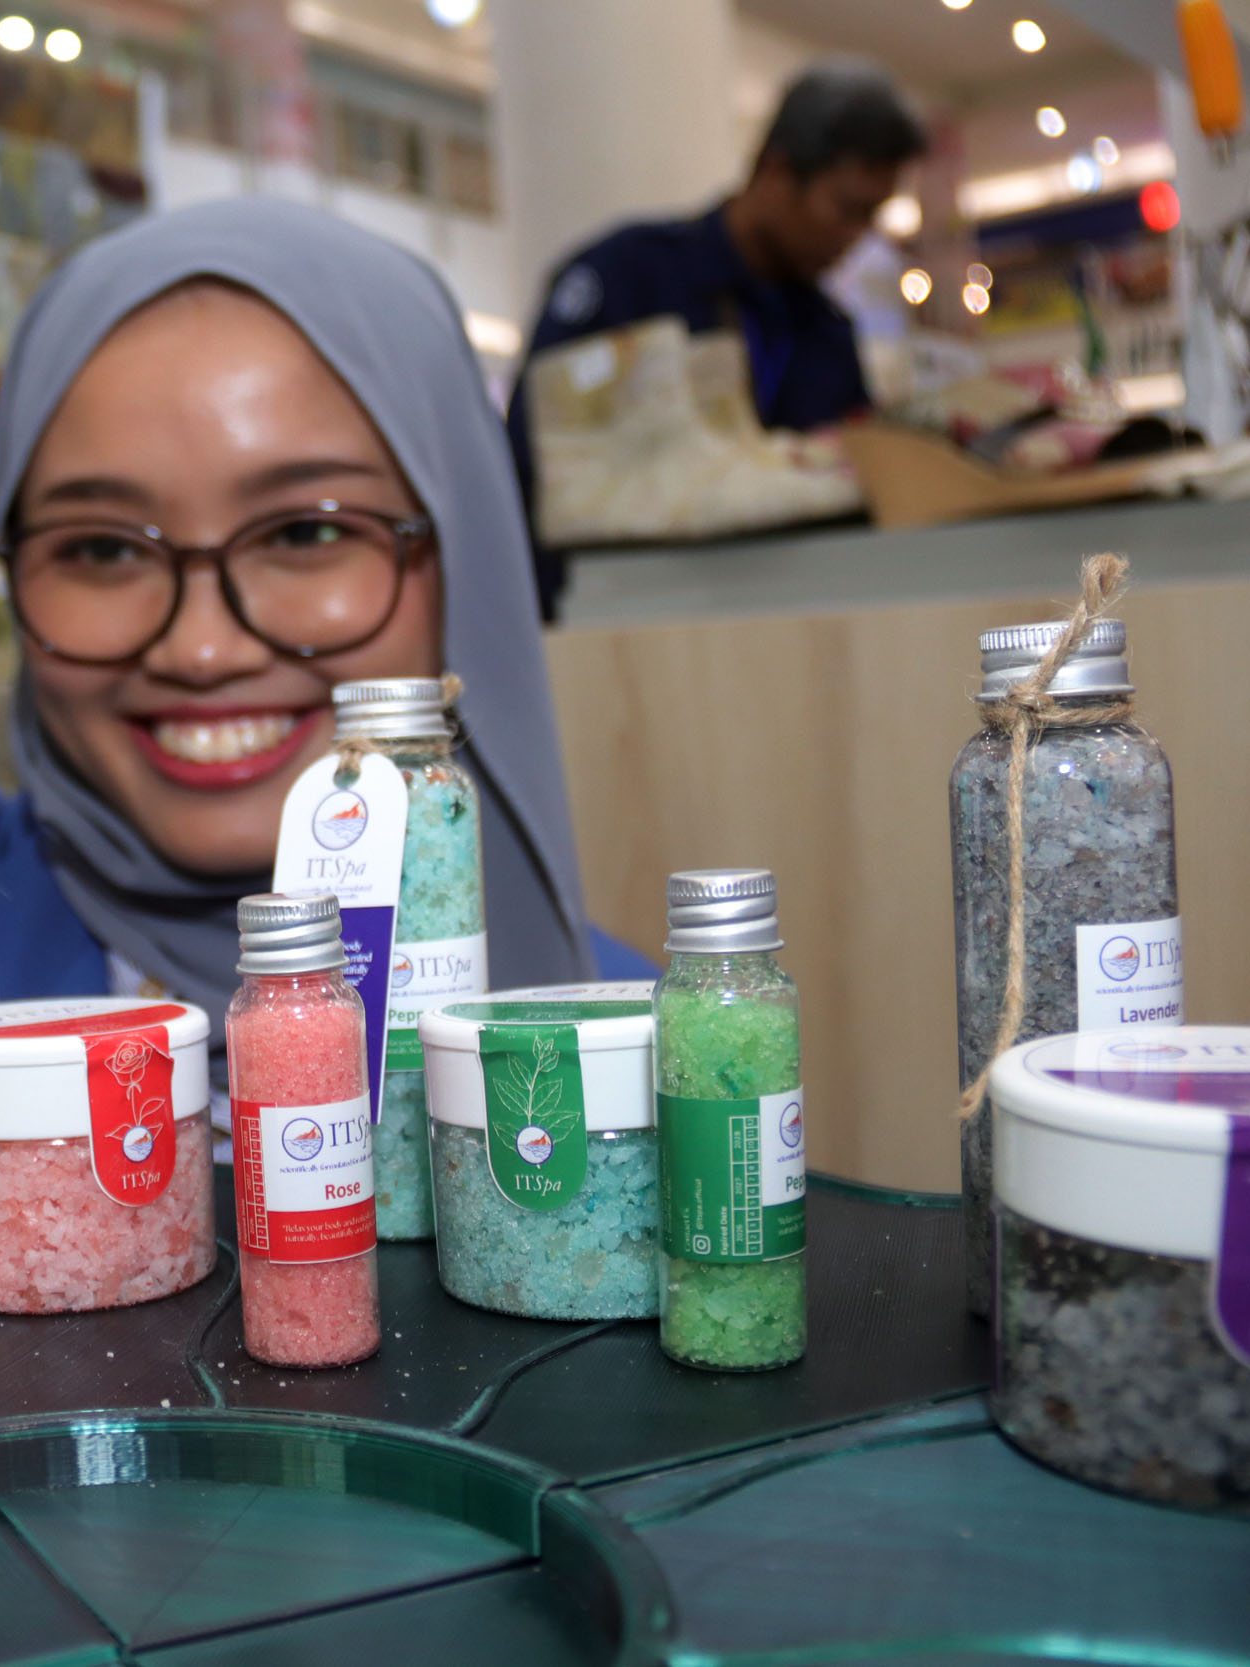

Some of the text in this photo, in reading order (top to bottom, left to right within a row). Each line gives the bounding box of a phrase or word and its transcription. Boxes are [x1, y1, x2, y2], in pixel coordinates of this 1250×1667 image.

[306, 857, 367, 884] ITSpa
[419, 953, 472, 982] ITSpa
[1120, 1000, 1179, 1024] Lavender
[121, 1169, 161, 1191] ITSpa
[325, 1181, 361, 1201] Rose
[514, 1173, 562, 1198] ITSpa
[720, 1206, 729, 1255] Expired Date
